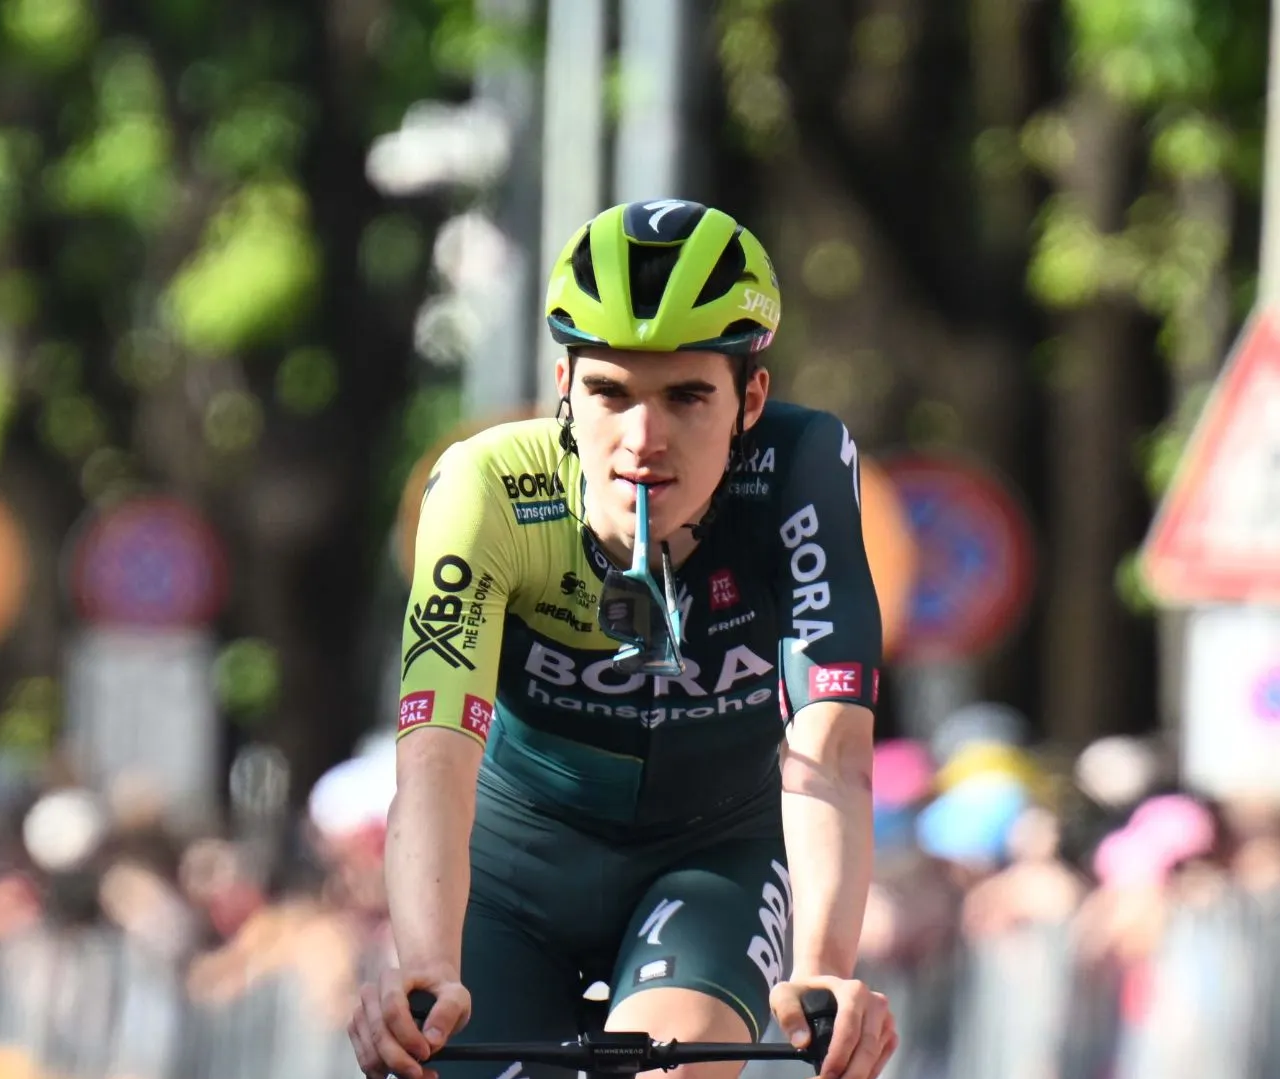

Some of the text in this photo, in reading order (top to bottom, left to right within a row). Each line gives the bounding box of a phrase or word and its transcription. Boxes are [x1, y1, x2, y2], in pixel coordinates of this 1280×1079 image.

[501, 472, 565, 498] BORA
[780, 504, 833, 654] BORA
[463, 573, 493, 649] THE FLEX OVEN
[525, 643, 774, 696] BORA
[816, 668, 855, 682] ÖTZ
[816, 682, 855, 692] TAL
[401, 699, 428, 714] ÖTZ
[527, 679, 772, 729] hansgrohe
[400, 712, 426, 726] TAL
[469, 716, 489, 734] TA
